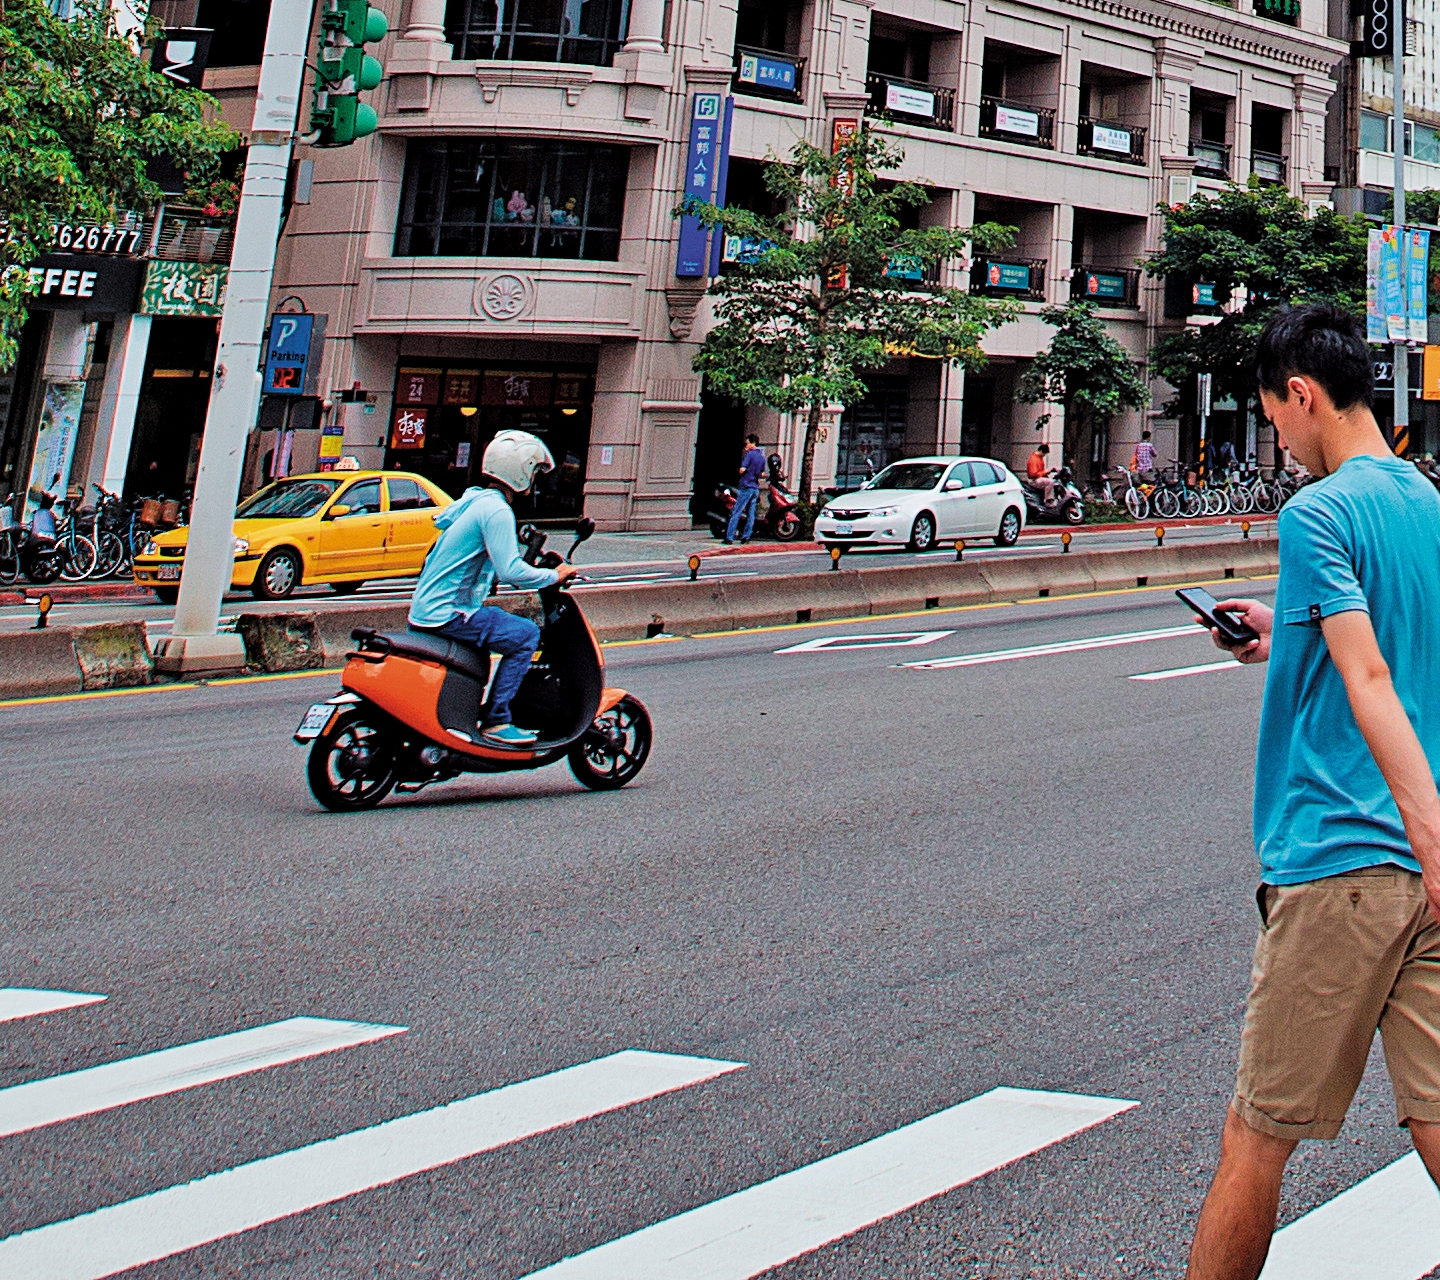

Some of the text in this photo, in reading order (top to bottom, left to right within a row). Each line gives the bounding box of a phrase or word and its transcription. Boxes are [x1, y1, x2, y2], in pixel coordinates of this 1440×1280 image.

[692, 126, 712, 188] 富邦人壽
[277, 319, 299, 348] P
[270, 351, 306, 365] Parking
[410, 383, 423, 397] 24
